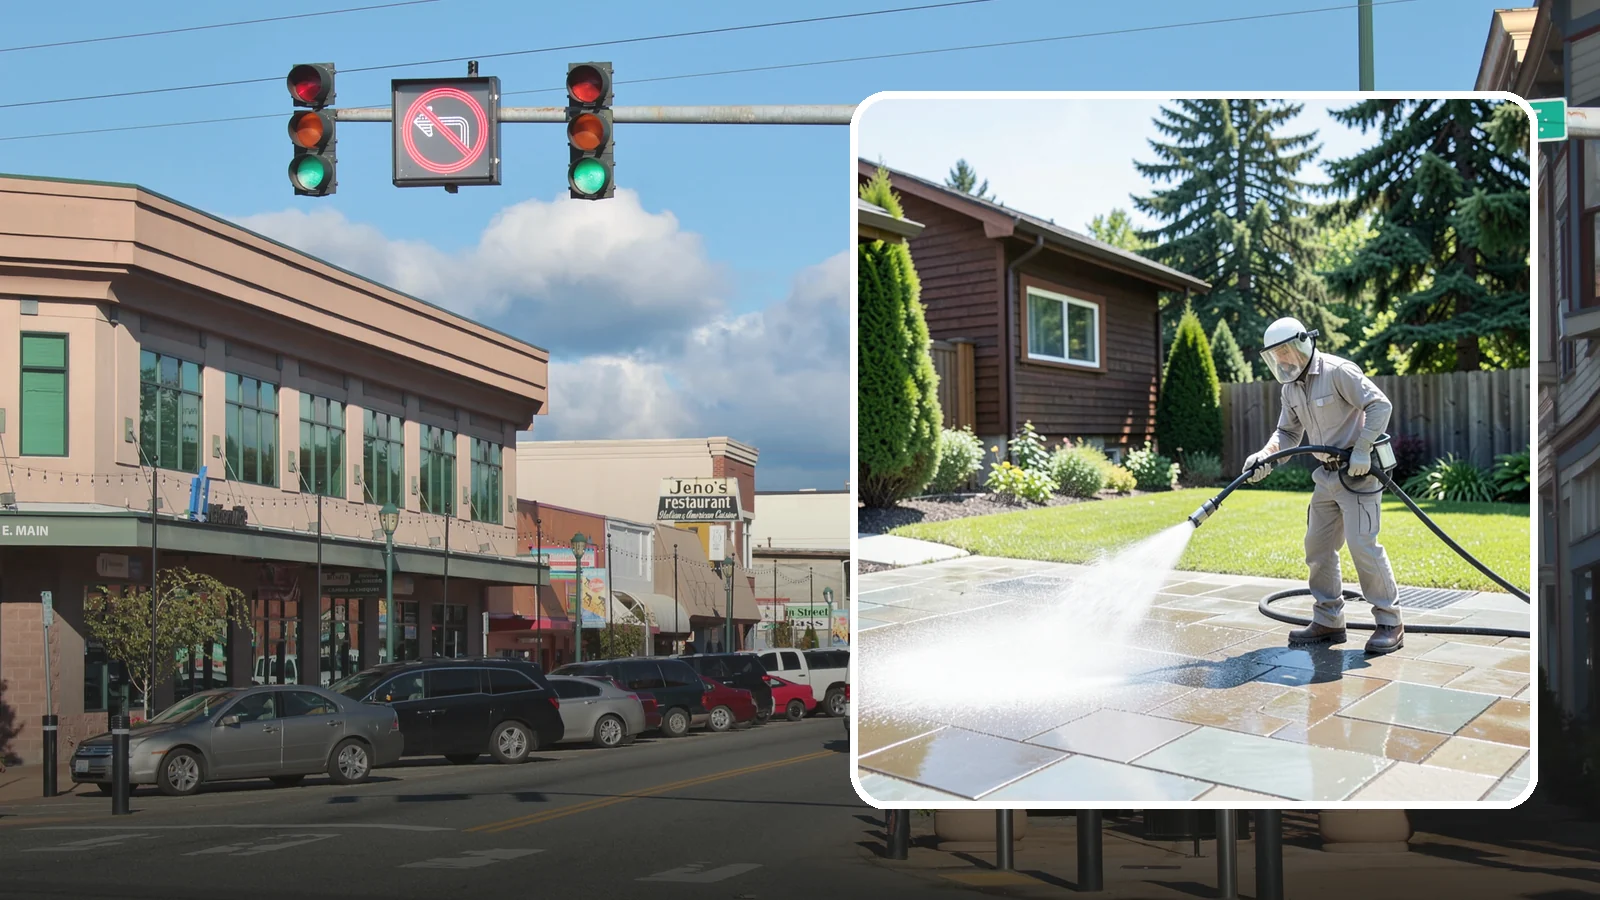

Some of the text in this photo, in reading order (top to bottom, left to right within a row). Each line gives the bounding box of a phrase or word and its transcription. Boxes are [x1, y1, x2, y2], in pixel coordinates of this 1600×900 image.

[669, 479, 727, 494] Jeno's
[665, 496, 730, 509] restaurant
[659, 510, 681, 520] Italian
[686, 510, 714, 520] American
[715, 510, 737, 520] Cuisine
[2, 525, 49, 536] E. MAIN
[797, 607, 828, 617] Street
[791, 618, 823, 627] lass
